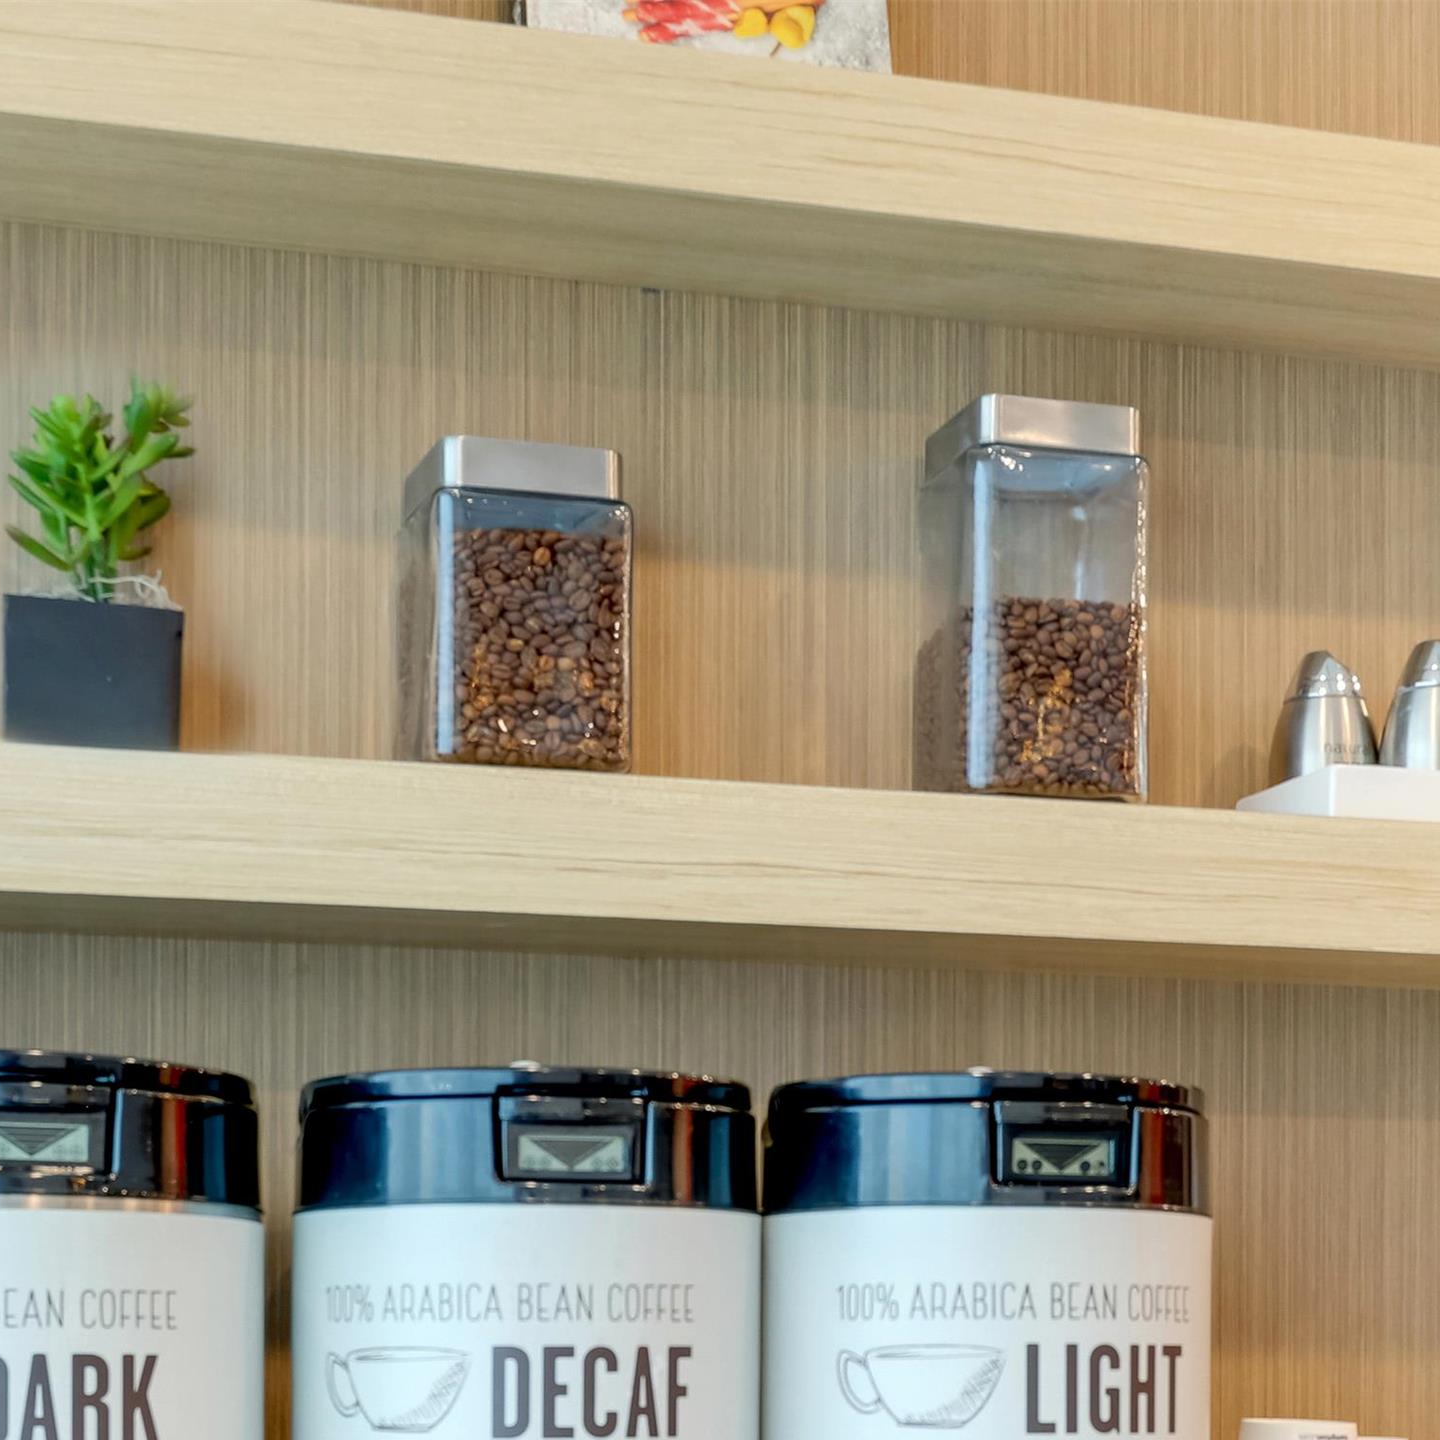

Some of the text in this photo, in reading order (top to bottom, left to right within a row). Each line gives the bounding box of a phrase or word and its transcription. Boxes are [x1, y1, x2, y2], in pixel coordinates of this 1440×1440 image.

[80, 1289, 178, 1331] COFFEE
[325, 1283, 694, 1324] 100% ARABICA BEAN COFFEE
[836, 1282, 1190, 1324] 100% ARABICA BEAN COFFEE
[491, 1346, 693, 1439] DECAF
[1026, 1344, 1182, 1433] LIGHT
